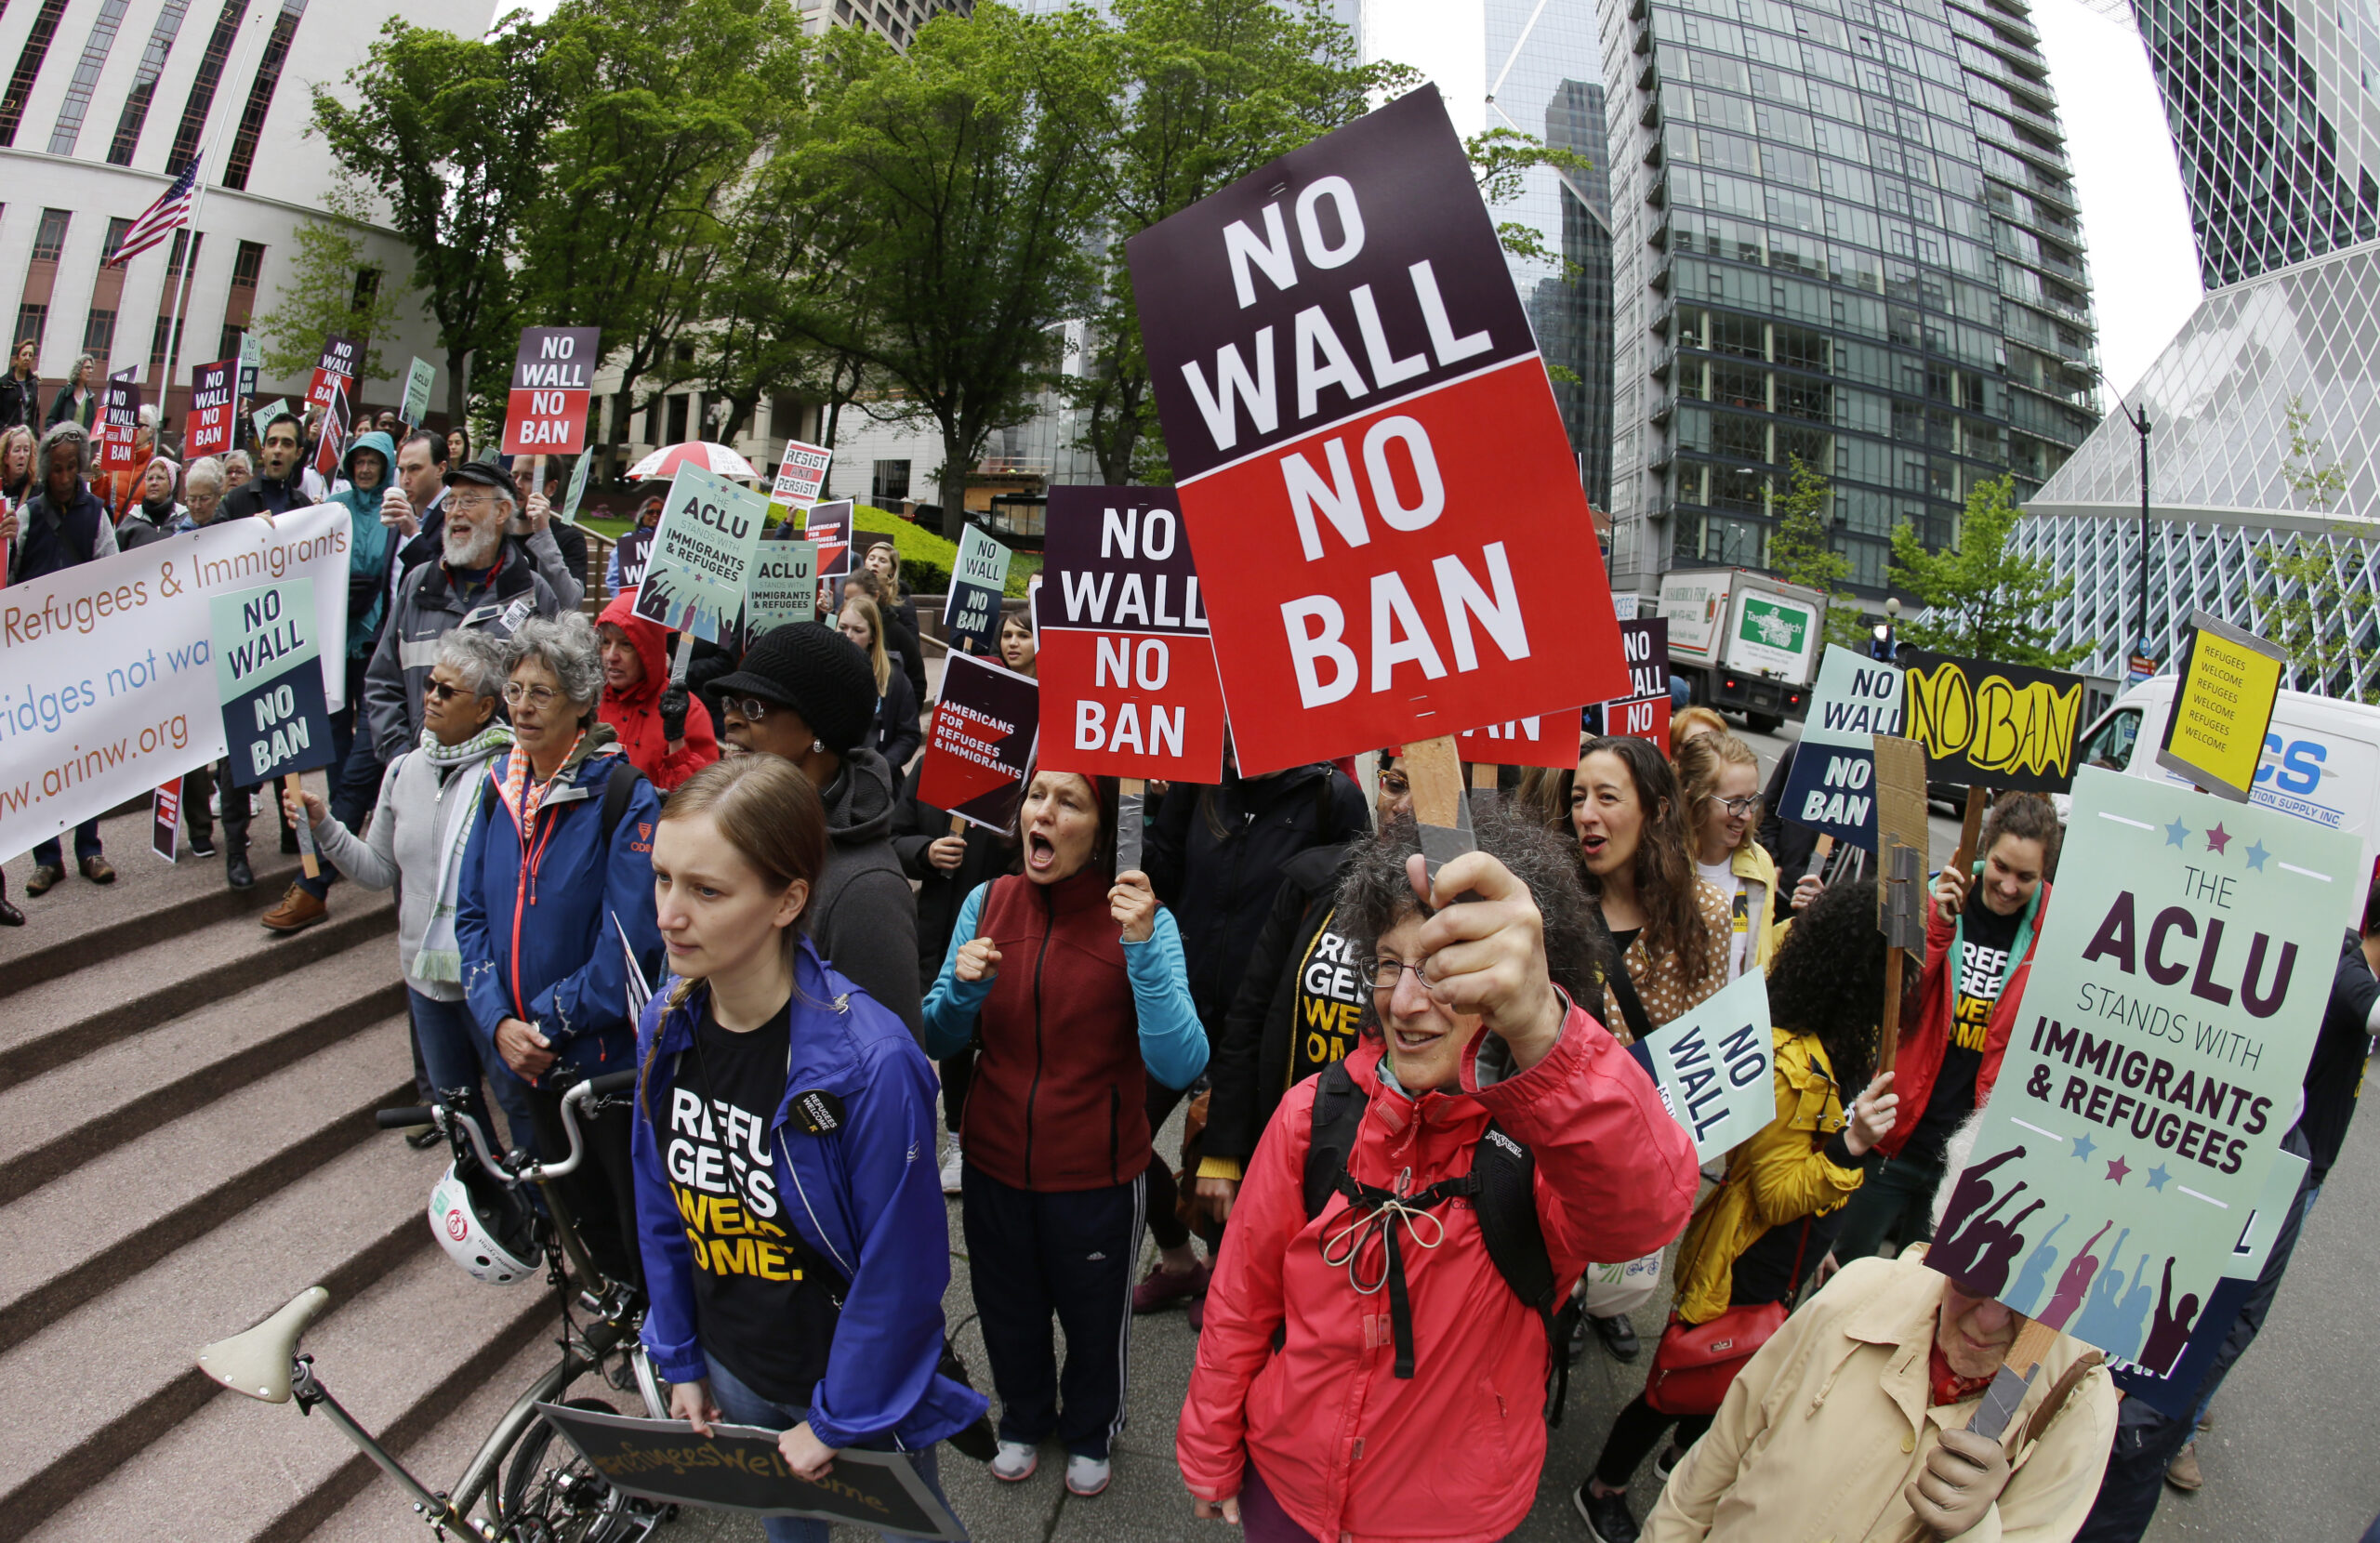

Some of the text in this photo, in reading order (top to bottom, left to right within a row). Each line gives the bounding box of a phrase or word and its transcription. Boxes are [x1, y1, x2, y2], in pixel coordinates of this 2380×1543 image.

[1222, 176, 1365, 310] NO
[243, 352, 258, 362] WALL
[247, 339, 257, 349] NO
[334, 341, 352, 359] NO
[540, 336, 575, 360] NO
[1181, 258, 1494, 451] WALL
[205, 371, 224, 389] NO
[243, 369, 253, 381] NO
[323, 354, 353, 376] WALL
[324, 372, 342, 388] NO
[414, 371, 430, 388] ACLU
[522, 364, 585, 387] WALL
[112, 390, 126, 406] NO
[195, 388, 230, 410] WALL
[240, 382, 254, 393] BAN
[314, 386, 334, 402] BA
[531, 391, 565, 415] NO
[110, 408, 136, 426] WALL
[201, 407, 219, 427] NO
[263, 404, 277, 420] NO
[120, 428, 134, 442] NO
[195, 426, 222, 446] BAN
[519, 420, 570, 444] BAN
[111, 444, 131, 461] BAN
[791, 467, 813, 480] AND
[1279, 415, 1446, 562] NO
[713, 494, 730, 508] THE
[681, 496, 749, 539] ACLU
[808, 522, 841, 532] AMERICANS
[667, 527, 745, 572] IMMIGRANTS
[681, 520, 741, 553] STANDS WITH
[976, 539, 997, 559] NO
[1101, 508, 1176, 560] NO
[666, 542, 739, 582] & REFUGEES
[759, 562, 807, 578] ACLU
[965, 558, 1000, 583] WALL
[4, 527, 347, 649] Refugees & Immigrants
[751, 591, 812, 600] IMMIGRANTS
[967, 589, 988, 611] NO
[1061, 571, 1209, 628] WALL
[243, 588, 283, 634] NO
[761, 600, 809, 609] REFUGEES
[956, 610, 988, 633] BAN
[1279, 541, 1531, 709] BAN
[228, 619, 307, 680] WALL
[1623, 630, 1650, 662] NO
[2204, 645, 2246, 671] REFUGEES
[1095, 636, 1170, 691] NO
[2201, 661, 2244, 688] WELCOME
[0, 679, 96, 742] ridges
[107, 649, 157, 697] not
[1851, 668, 1895, 700] NO
[2196, 678, 2239, 704] REFUGEES
[253, 684, 296, 732] NO
[939, 712, 964, 730] FOR
[942, 700, 1014, 735] AMERICANS
[1627, 702, 1653, 734] NO
[1824, 701, 1902, 735] WALL
[1906, 663, 2082, 778] NO BAN
[2188, 709, 2230, 736] REFUGEES
[2193, 693, 2236, 720] WELCOME
[936, 725, 1001, 758] REFUGEES
[1074, 699, 1185, 758] BAN
[2185, 725, 2228, 753] WELCOME
[250, 716, 311, 776] BAN
[933, 737, 1023, 780] & IMMIGRANTS
[1824, 756, 1871, 790] NO
[2254, 732, 2327, 795] CS
[1801, 790, 1871, 826] BAN
[2278, 798, 2318, 818] SUPPLY
[2320, 811, 2342, 826] INC.
[2185, 864, 2238, 910] THE
[1963, 941, 2010, 974] REF
[2082, 890, 2299, 1019] ACLU
[1960, 965, 2003, 998] GEE
[1303, 996, 1362, 1035] WE
[2076, 983, 2264, 1072] STANDS WITH
[1718, 1023, 1766, 1091] NO
[1668, 1025, 1731, 1145] WALL
[2029, 1015, 2274, 1137] IMMIGRANTS
[803, 1097, 830, 1131] WELCOME
[809, 1093, 838, 1128] REFUGEES
[2026, 1062, 2249, 1177] & REFUGEES
[671, 1087, 774, 1167] REFU
[668, 1138, 778, 1218] GEES
[669, 1180, 794, 1254] WELC
